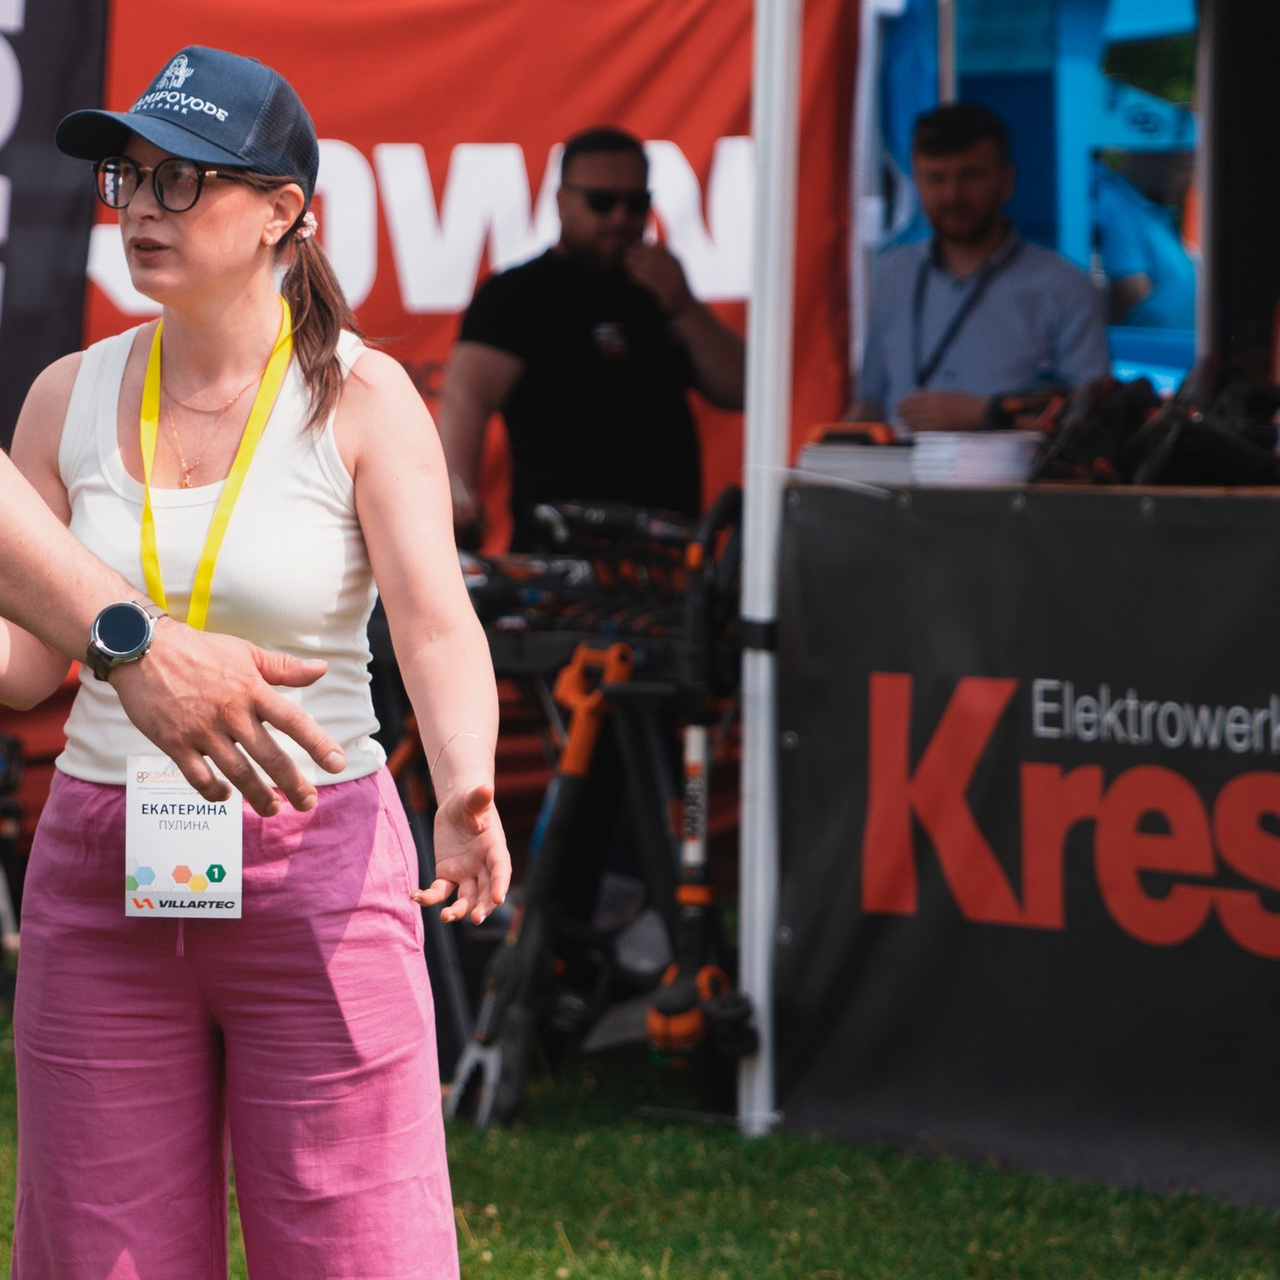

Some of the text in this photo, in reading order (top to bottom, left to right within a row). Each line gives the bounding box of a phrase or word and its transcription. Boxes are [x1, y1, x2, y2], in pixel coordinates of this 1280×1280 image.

[141, 803, 227, 816] ЕКАТЕРИНА
[159, 820, 210, 831] ПУЛИНА
[212, 867, 219, 879] 1
[159, 900, 235, 909] VILLARTEC
